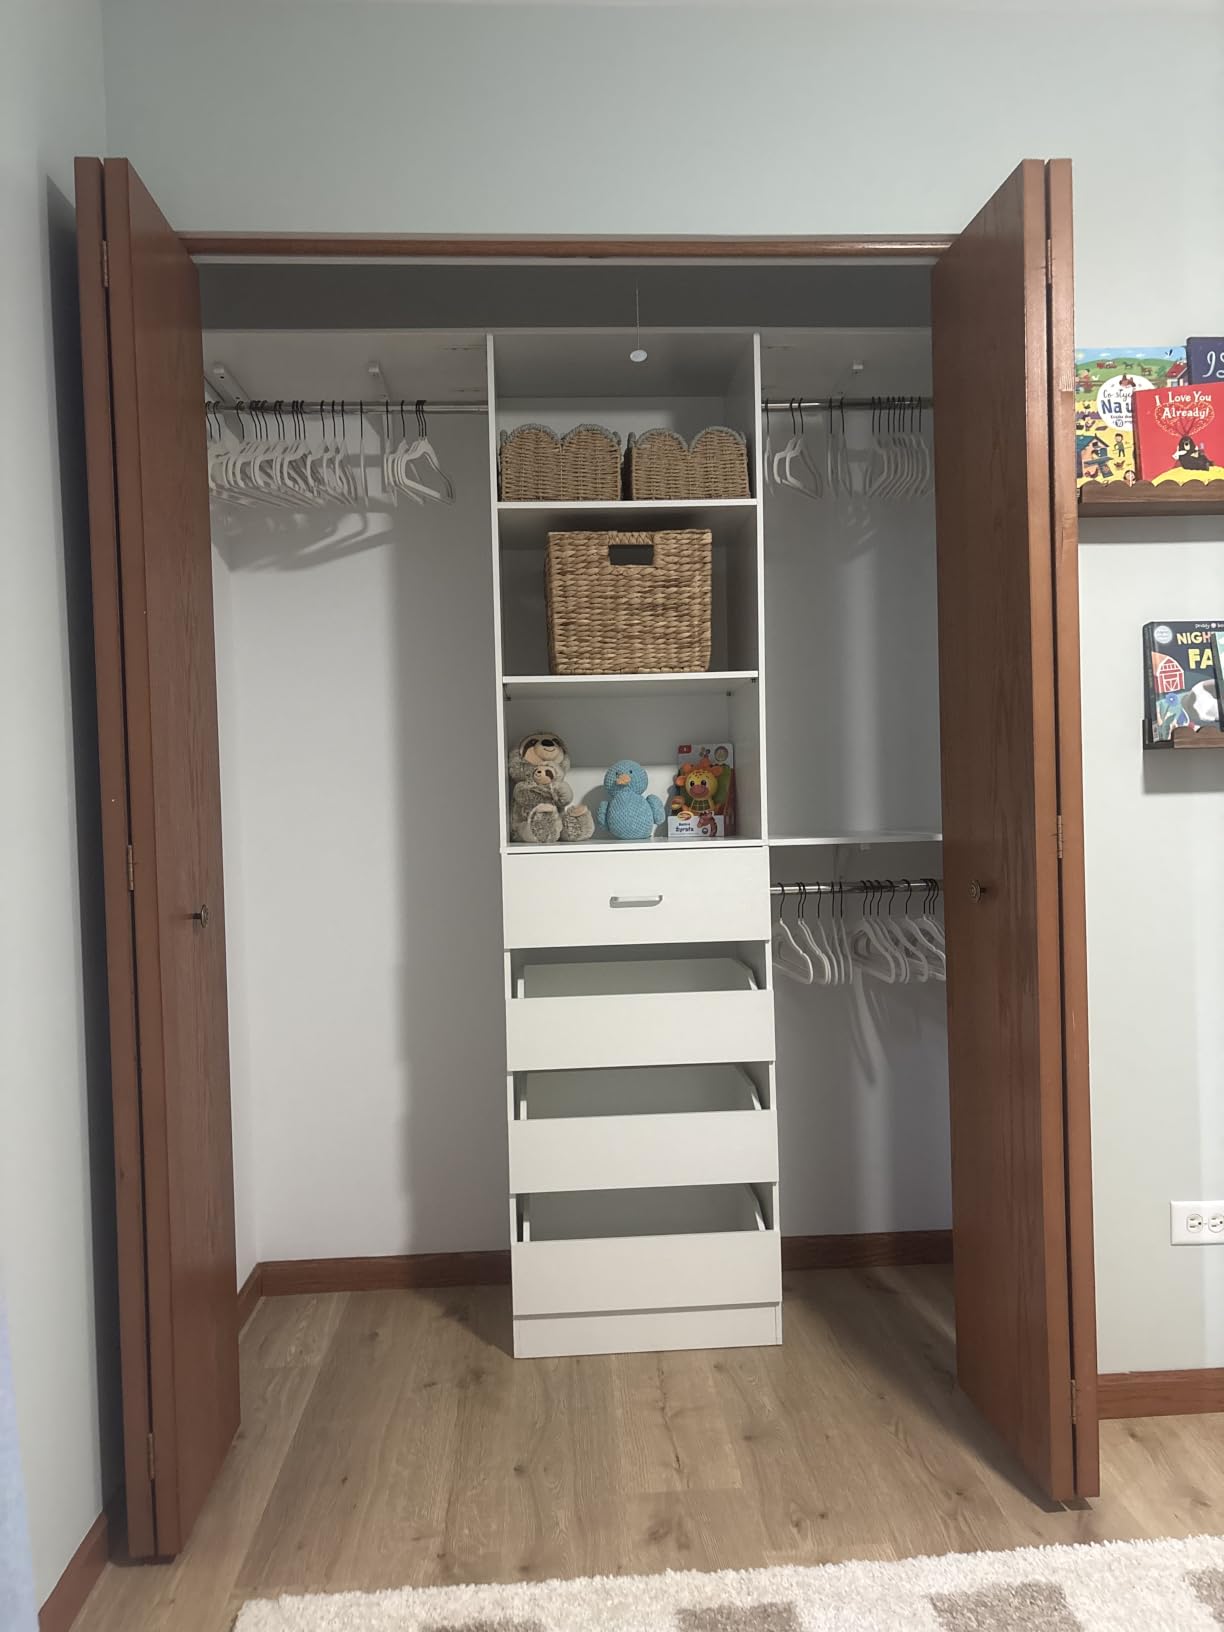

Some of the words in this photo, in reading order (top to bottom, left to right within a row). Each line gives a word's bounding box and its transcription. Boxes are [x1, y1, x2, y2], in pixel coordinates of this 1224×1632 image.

[1154, 394, 1162, 406] I
[1168, 391, 1192, 403] Love
[1193, 390, 1212, 403] You
[1101, 399, 1123, 414] Na
[1162, 407, 1209, 419] Already!
[1176, 631, 1214, 645] NIGH
